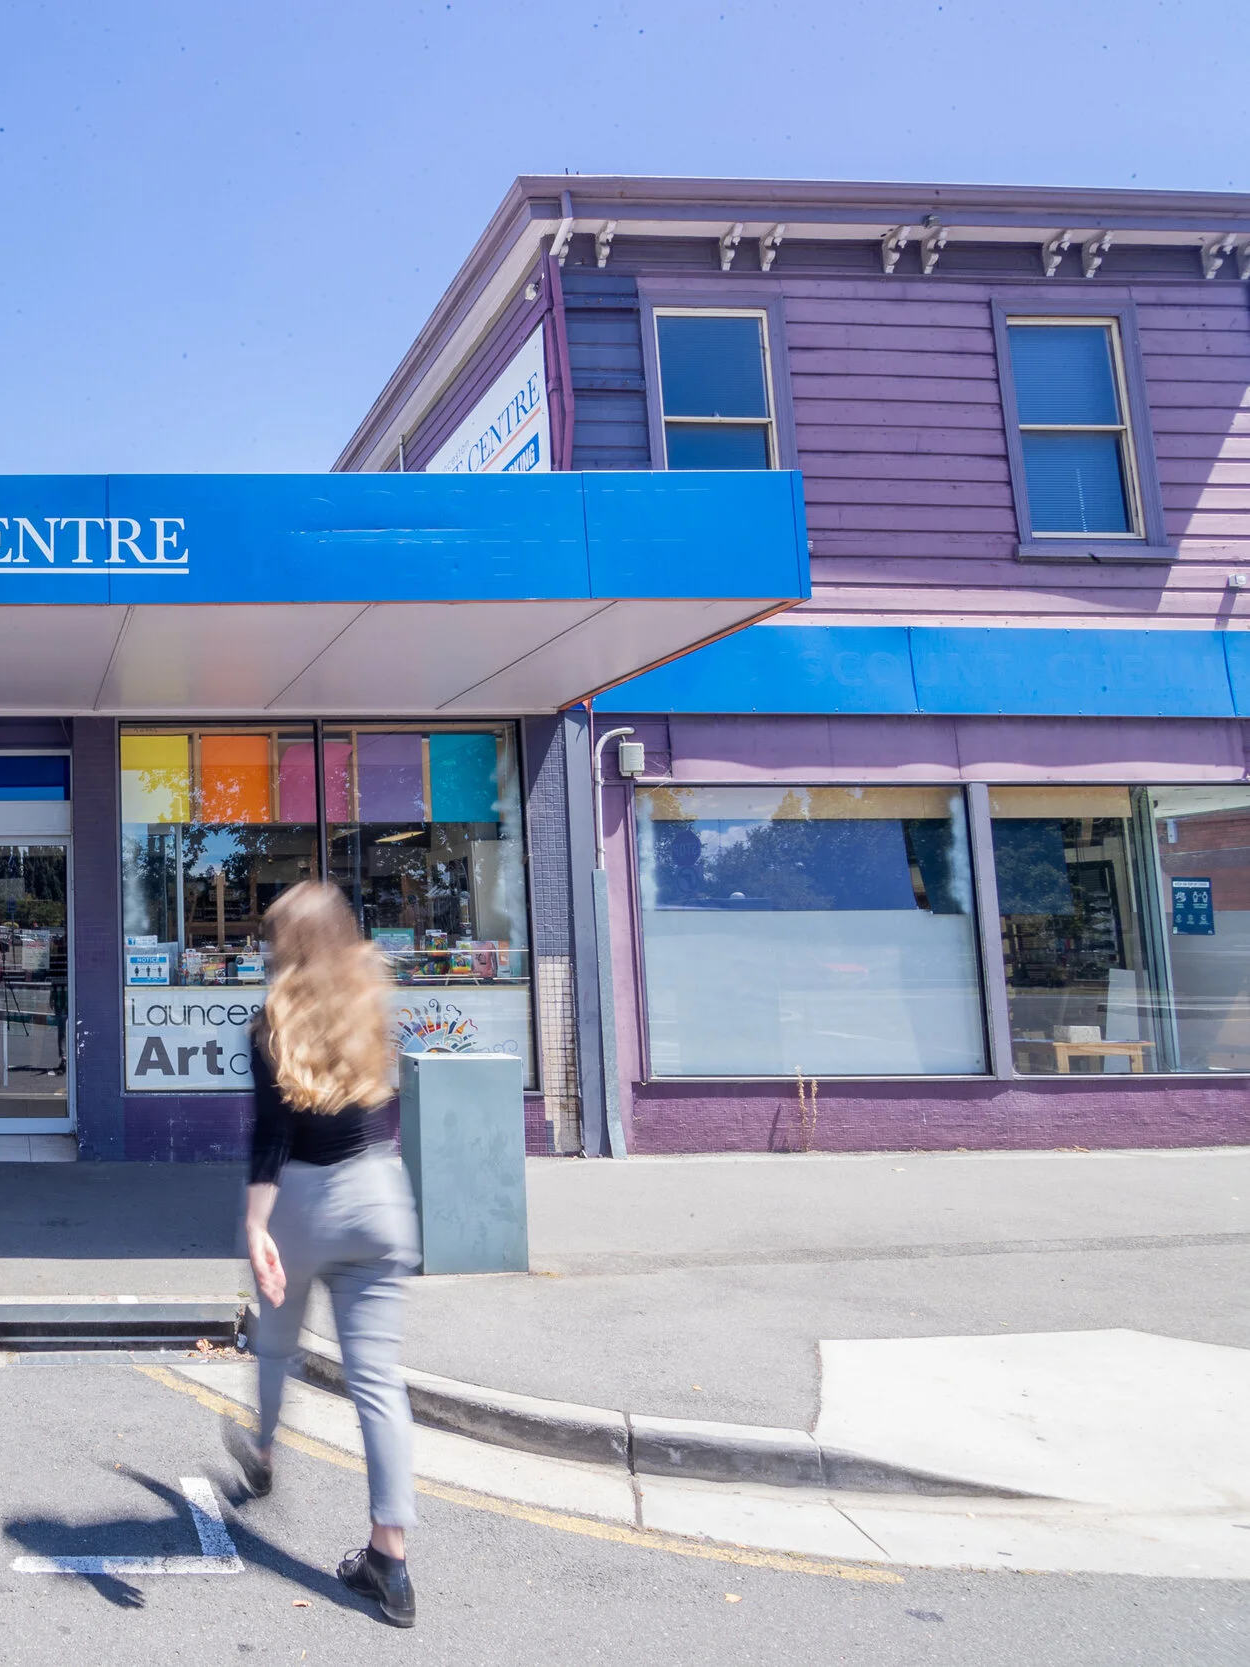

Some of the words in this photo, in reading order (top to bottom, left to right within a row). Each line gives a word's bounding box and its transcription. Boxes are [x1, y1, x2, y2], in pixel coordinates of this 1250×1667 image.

[468, 371, 540, 471] CENTRE
[131, 998, 263, 1026] Launces
[134, 1036, 225, 1076] Art
